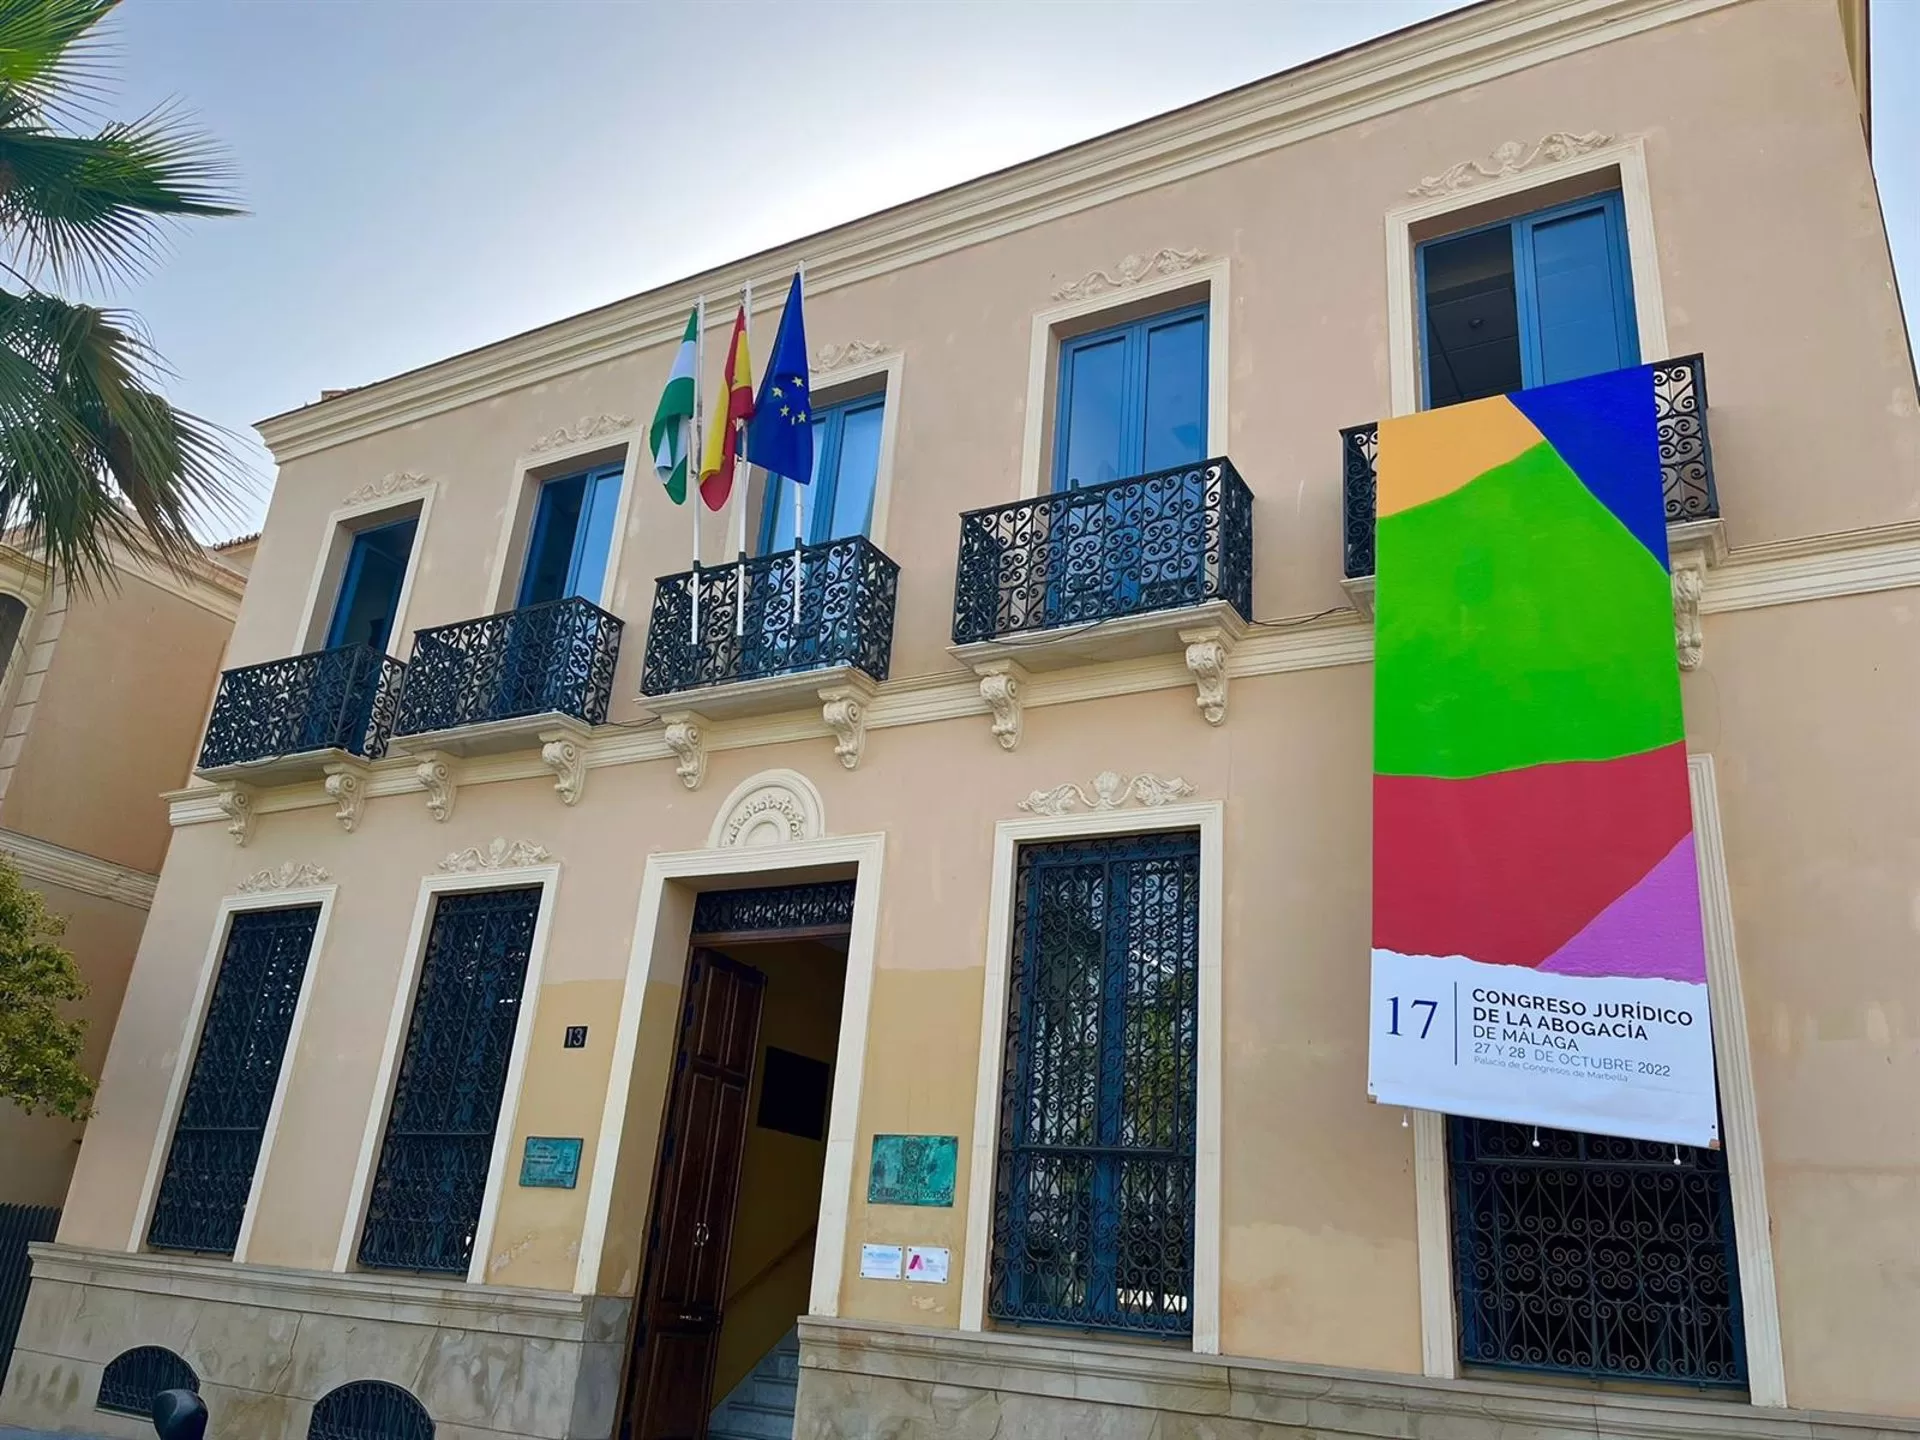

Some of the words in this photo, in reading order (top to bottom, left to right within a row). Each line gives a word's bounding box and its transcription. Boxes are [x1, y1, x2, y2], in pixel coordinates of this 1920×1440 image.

[1386, 996, 1438, 1039] 17
[1472, 988, 1586, 1016] CONGRESO
[1593, 1001, 1693, 1026] JURÍDICO
[1473, 1007, 1500, 1023] DE
[1506, 1011, 1532, 1028] LA
[1537, 1015, 1648, 1040] ABOGACÍA
[568, 1028, 583, 1046] 13
[1473, 1025, 1497, 1040] DE
[1502, 1027, 1579, 1051] MÁLAGA
[1473, 1056, 1506, 1068] Palacio
[1508, 1060, 1520, 1069] de
[1522, 1062, 1571, 1077] Congresos
[1572, 1069, 1585, 1078] de
[1587, 1070, 1628, 1083] Marbella
[1474, 1042, 1491, 1054] 27
[1495, 1044, 1505, 1056] Y
[1508, 1046, 1526, 1059] 28
[1534, 1049, 1554, 1063] DE
[1558, 1052, 1634, 1072] OCTUBRE
[1638, 1061, 1671, 1077] 2022
